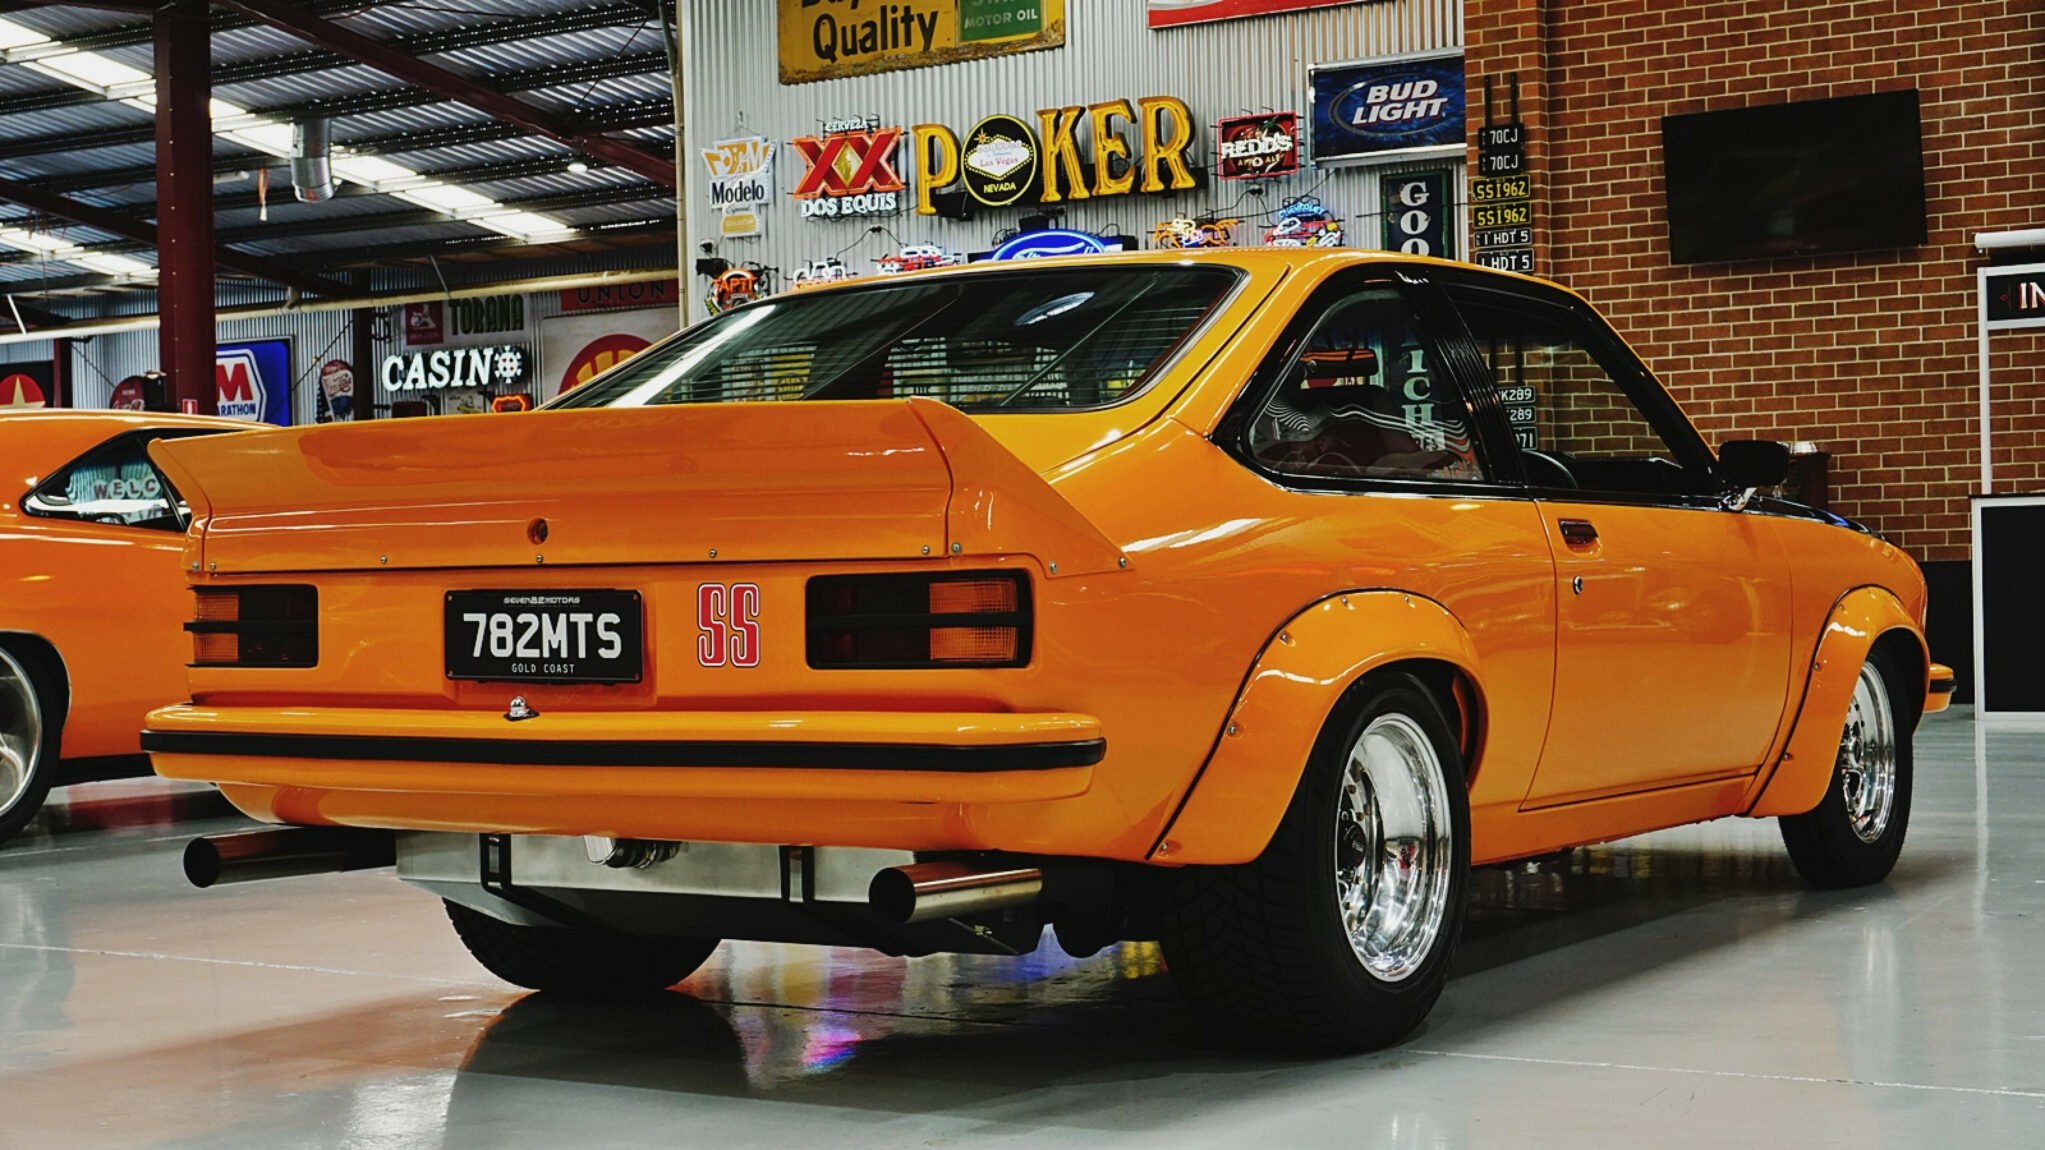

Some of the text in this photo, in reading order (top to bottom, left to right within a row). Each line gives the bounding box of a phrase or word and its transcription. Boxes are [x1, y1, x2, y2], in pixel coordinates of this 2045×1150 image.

[964, 8, 1038, 29] MOTOR OIL
[813, 5, 938, 63] Quality
[1366, 80, 1438, 104] BUD
[1352, 98, 1448, 125] LIGHT
[826, 119, 868, 131] CERVEZA
[1489, 128, 1518, 144] 70CJ
[1489, 154, 1519, 170] 70CJ
[712, 179, 764, 204] Modelo
[983, 182, 1017, 193] NEVADA
[801, 193, 897, 218] DOS EQUIS
[1493, 230, 1517, 245] HDT
[1520, 230, 1528, 242] 5
[1491, 255, 1517, 270] HDT
[1521, 255, 1530, 269] 5
[577, 281, 664, 304] UNION
[448, 295, 524, 335] TORANA
[1499, 389, 1532, 401] K289
[463, 613, 622, 659] 782MTS
[697, 583, 760, 667] SS
[511, 662, 575, 674] GOLD COAST
